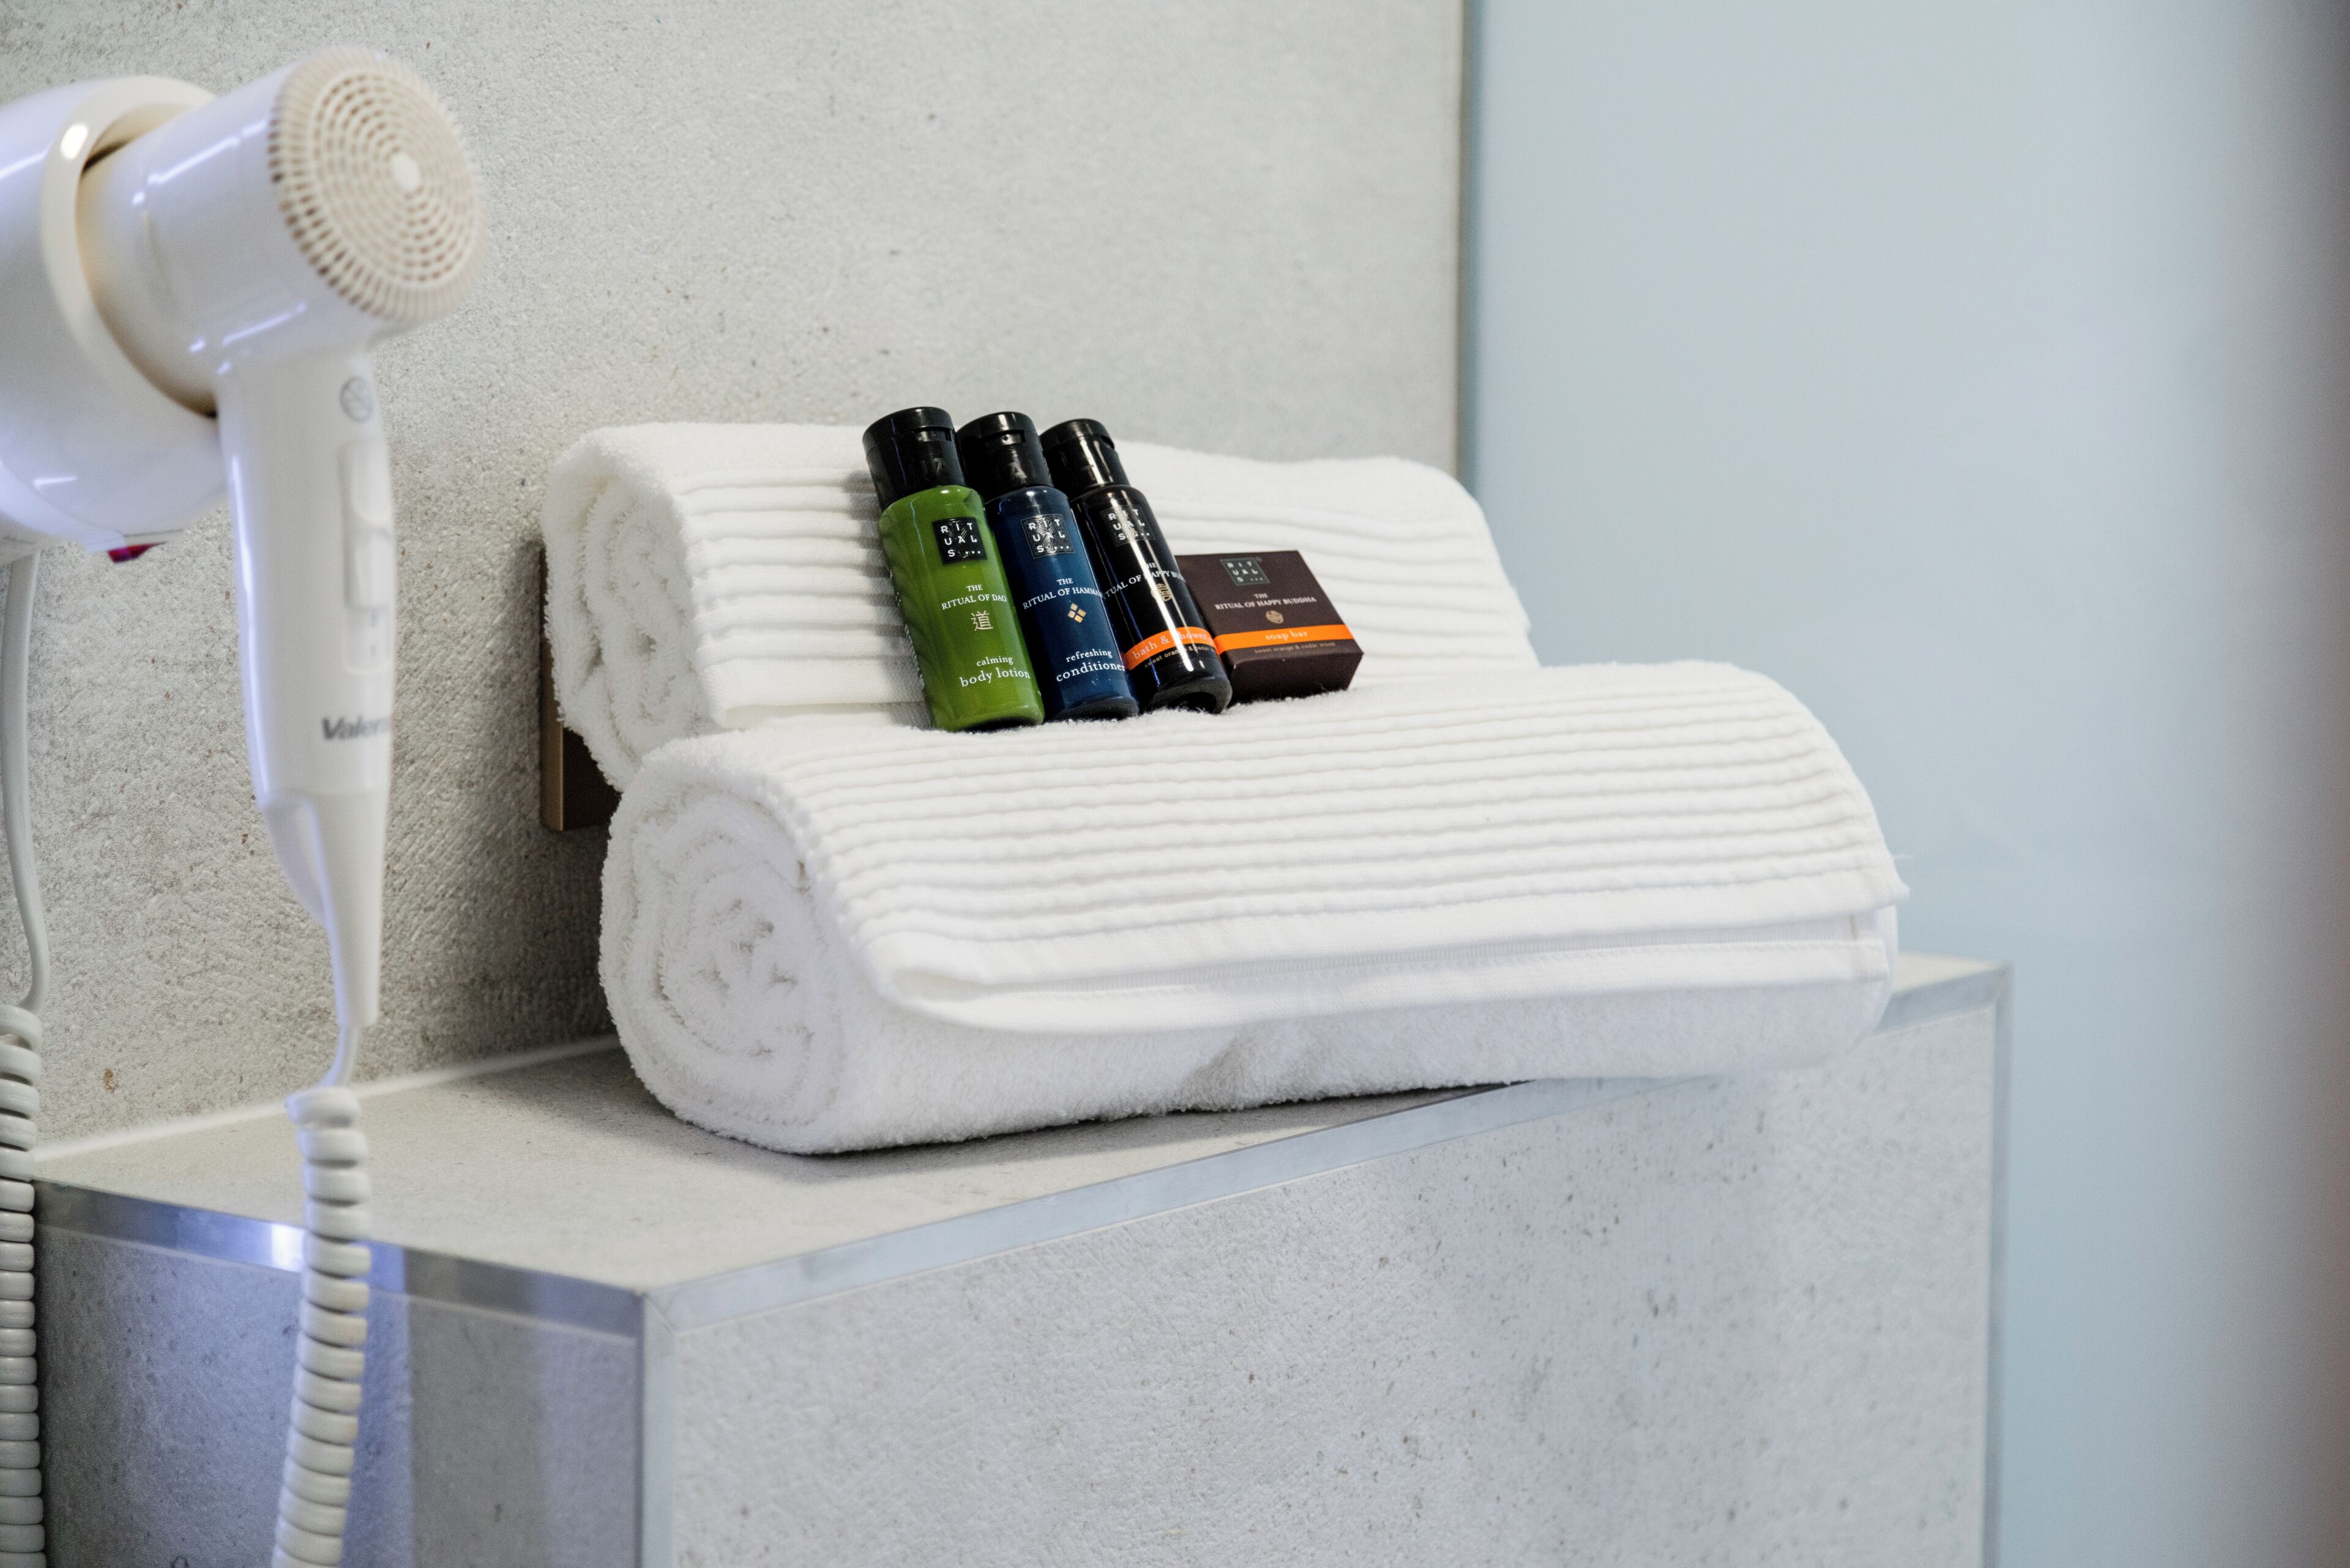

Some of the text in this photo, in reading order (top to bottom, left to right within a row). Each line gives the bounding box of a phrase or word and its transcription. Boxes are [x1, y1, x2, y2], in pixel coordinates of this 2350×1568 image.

[1128, 575, 1141, 584] OF
[1143, 570, 1170, 580] APPY
[941, 595, 976, 610] RITUAL
[991, 594, 1007, 602] DAO
[1023, 592, 1056, 610] RITUAL
[1256, 599, 1281, 607] HAPPY
[971, 610, 993, 632] 道
[1133, 641, 1158, 659] bath
[1160, 635, 1170, 644] &
[1176, 631, 1207, 641] hower
[1165, 648, 1187, 658] orane
[976, 655, 1013, 665] calming
[1066, 648, 1113, 663] refreshing
[959, 667, 1030, 687] body lotion
[1056, 661, 1125, 682] conditioner
